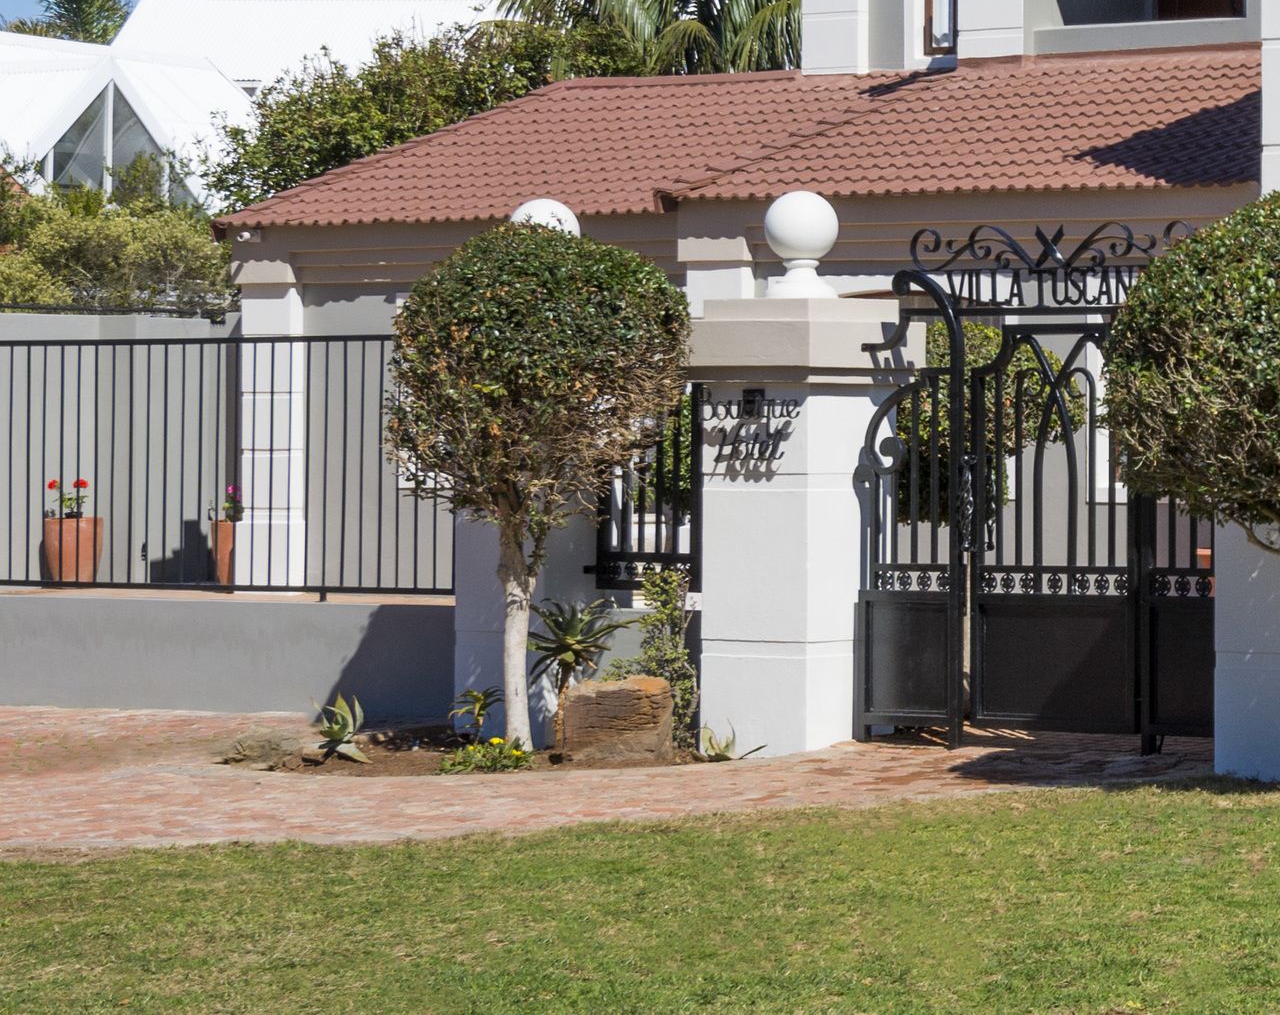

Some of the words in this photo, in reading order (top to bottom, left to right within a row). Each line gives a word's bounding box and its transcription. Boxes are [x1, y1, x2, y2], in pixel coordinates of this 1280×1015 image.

[946, 269, 1027, 308] VILLA
[1028, 267, 1135, 307] TUSCAN
[714, 423, 785, 463] Hotel
